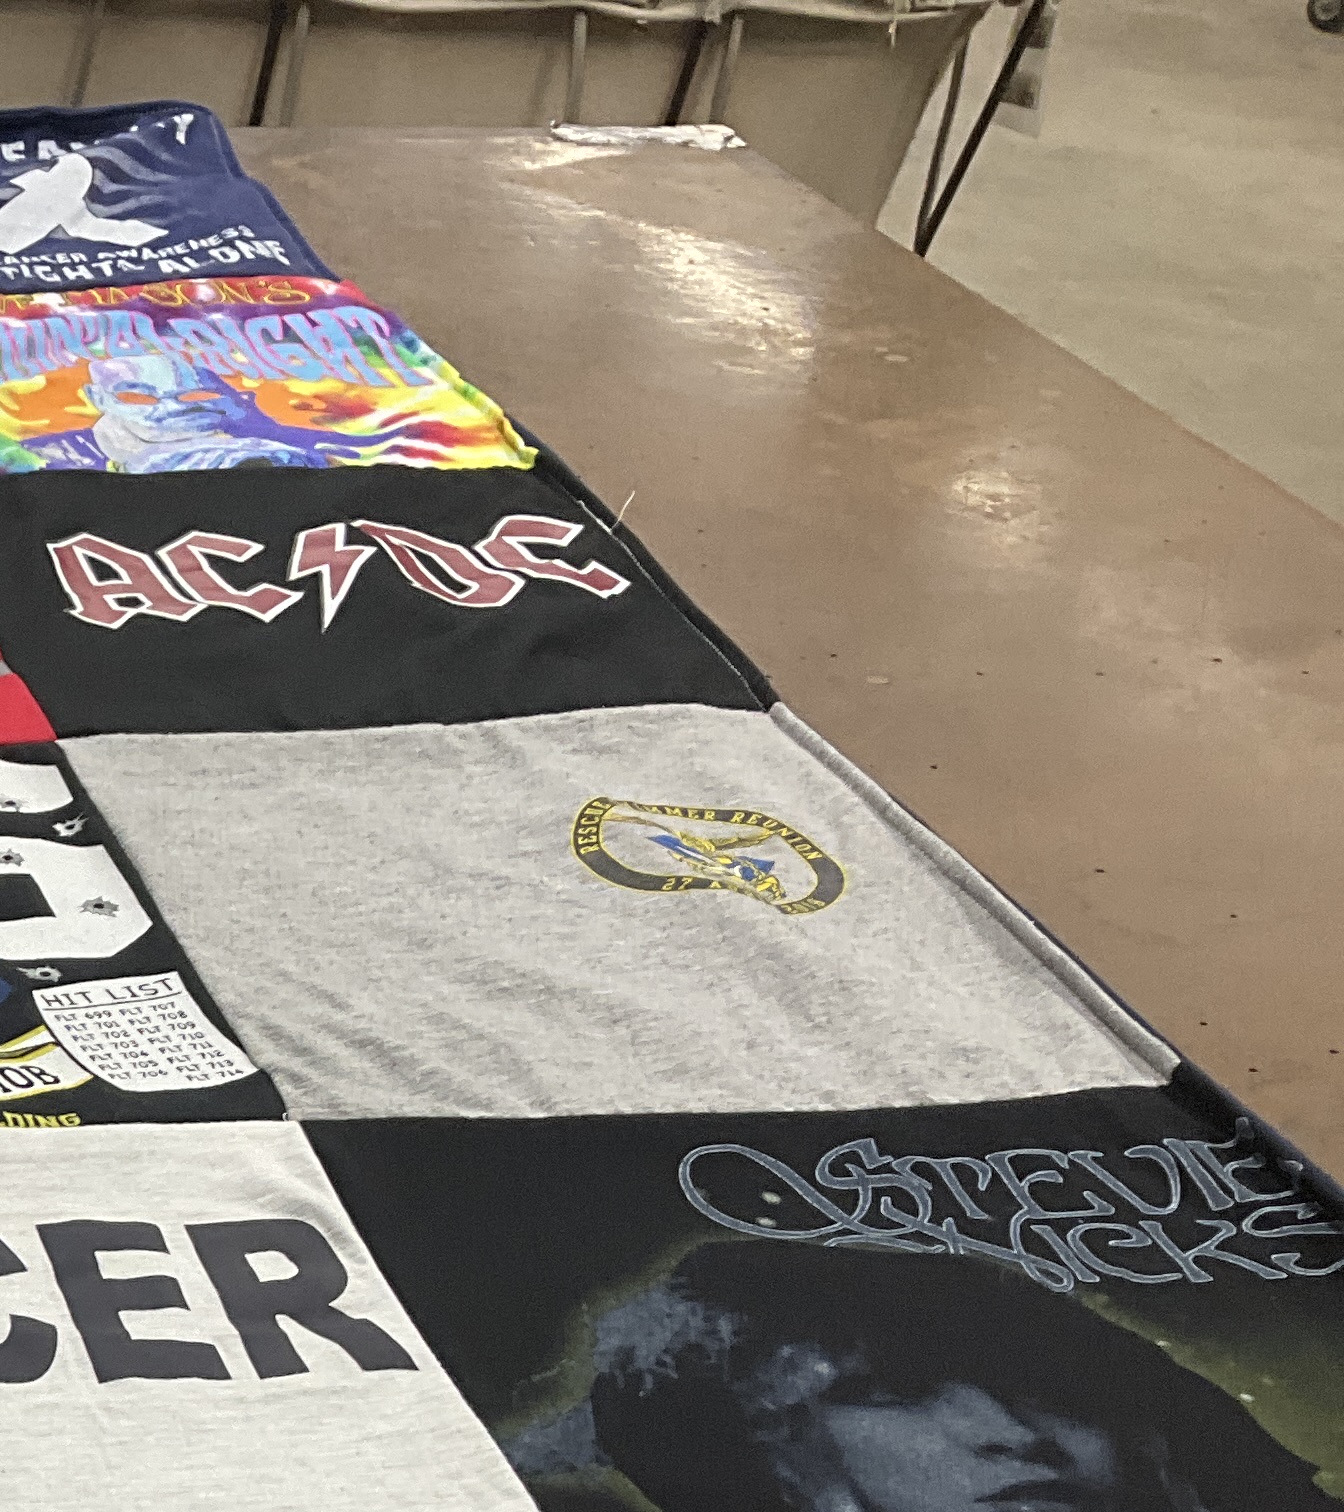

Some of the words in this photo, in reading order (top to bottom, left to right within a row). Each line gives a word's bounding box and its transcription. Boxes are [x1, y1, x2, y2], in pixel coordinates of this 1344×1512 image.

[157, 239, 292, 275] ALONE
[576, 797, 612, 855] RESCUE
[731, 811, 824, 860] REUNION
[662, 877, 692, 891] 27
[40, 990, 92, 1008] HIT
[105, 978, 176, 1000] LIST
[55, 1012, 77, 1022] FLT
[84, 1010, 112, 1020] 699
[119, 1006, 142, 1017] FLT
[149, 1001, 176, 1012] 707
[64, 1023, 88, 1032] FLT
[95, 1020, 121, 1029] 701
[128, 1016, 151, 1026] FLT
[158, 1010, 188, 1021] 708
[71, 1033, 95, 1043] FLT
[103, 1030, 131, 1040] 702
[137, 1026, 161, 1036] FLT
[168, 1021, 197, 1031] 709
[80, 1043, 104, 1053] FLT
[111, 1040, 139, 1050] 703
[147, 1035, 172, 1045] FLT
[177, 1031, 205, 1041] 710
[89, 1052, 113, 1063] FLT
[118, 1050, 149, 1060] 704
[158, 1045, 182, 1055] FLT
[187, 1041, 214, 1051] 711
[98, 1062, 123, 1072] FLT
[130, 1059, 159, 1069] 705
[166, 1054, 191, 1065] FLT
[196, 1050, 226, 1061] 712
[108, 1071, 131, 1081] FLT
[136, 1069, 169, 1079] 706
[175, 1064, 201, 1074] FLT
[206, 1059, 234, 1070] 713
[185, 1073, 210, 1083] FLT
[215, 1068, 245, 1079] 714
